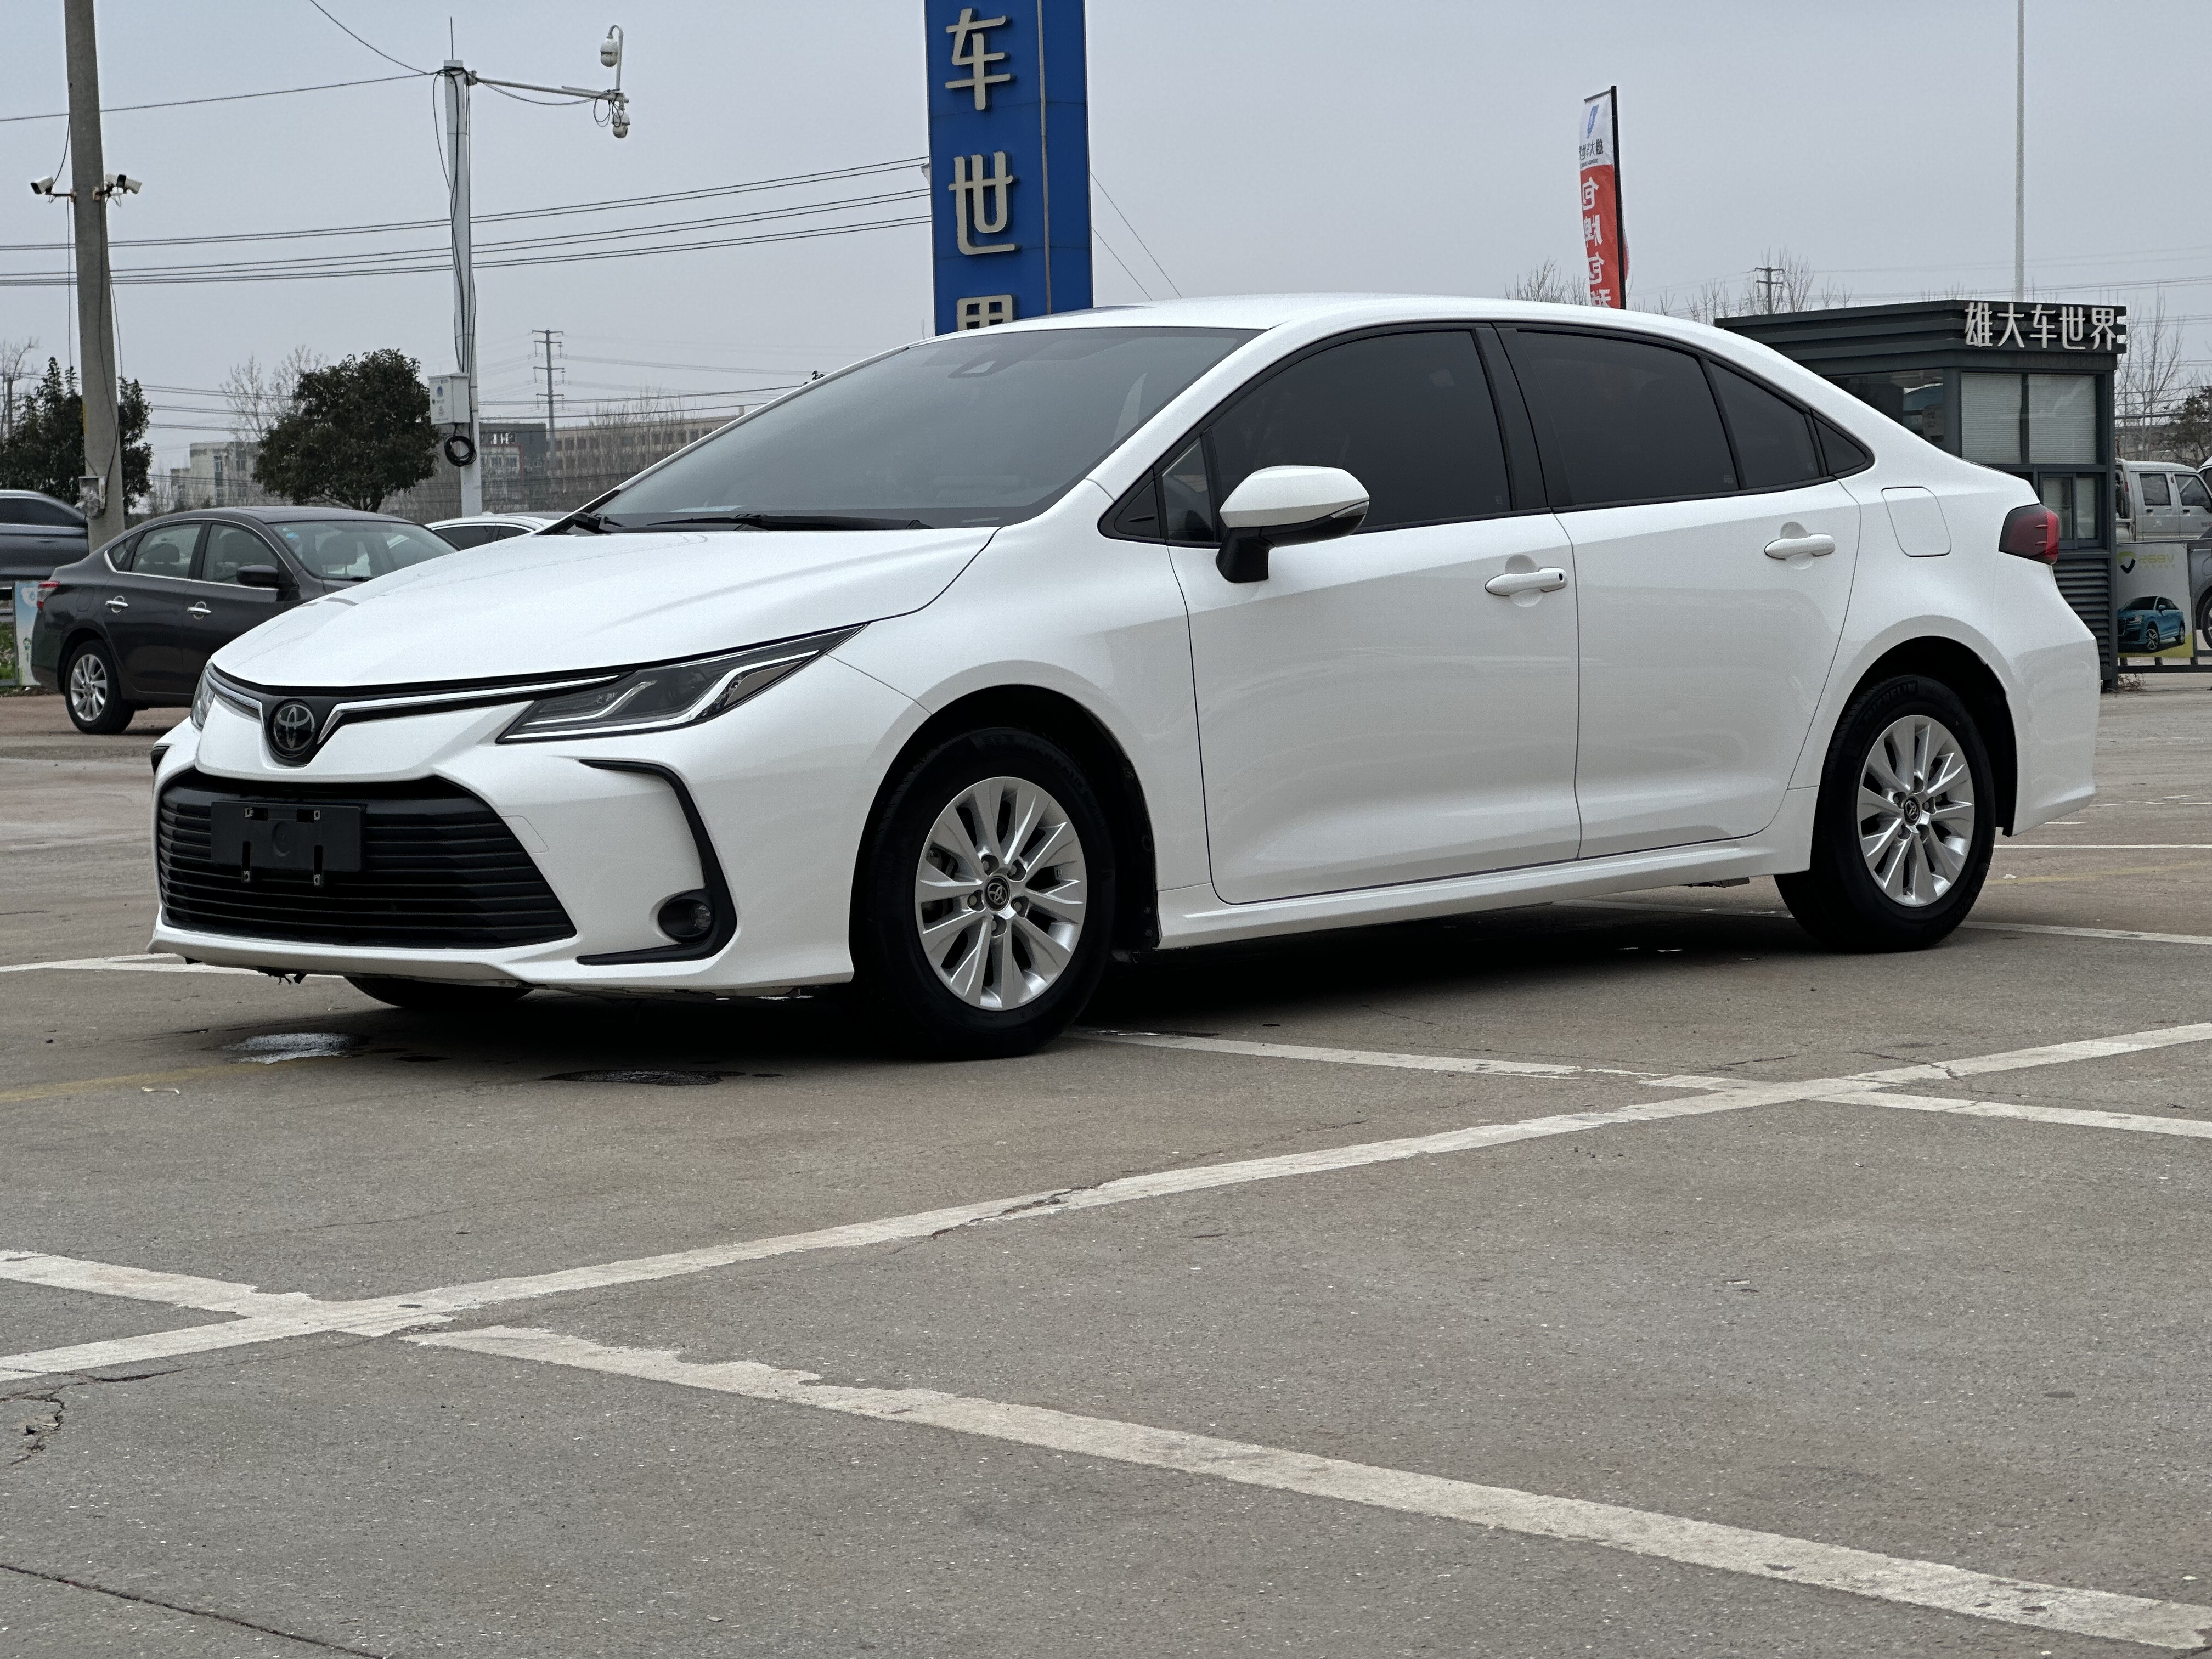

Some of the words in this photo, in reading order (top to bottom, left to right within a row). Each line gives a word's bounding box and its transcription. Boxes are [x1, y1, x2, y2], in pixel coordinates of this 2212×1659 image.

[1964, 302, 2116, 351] 雄大车世界
